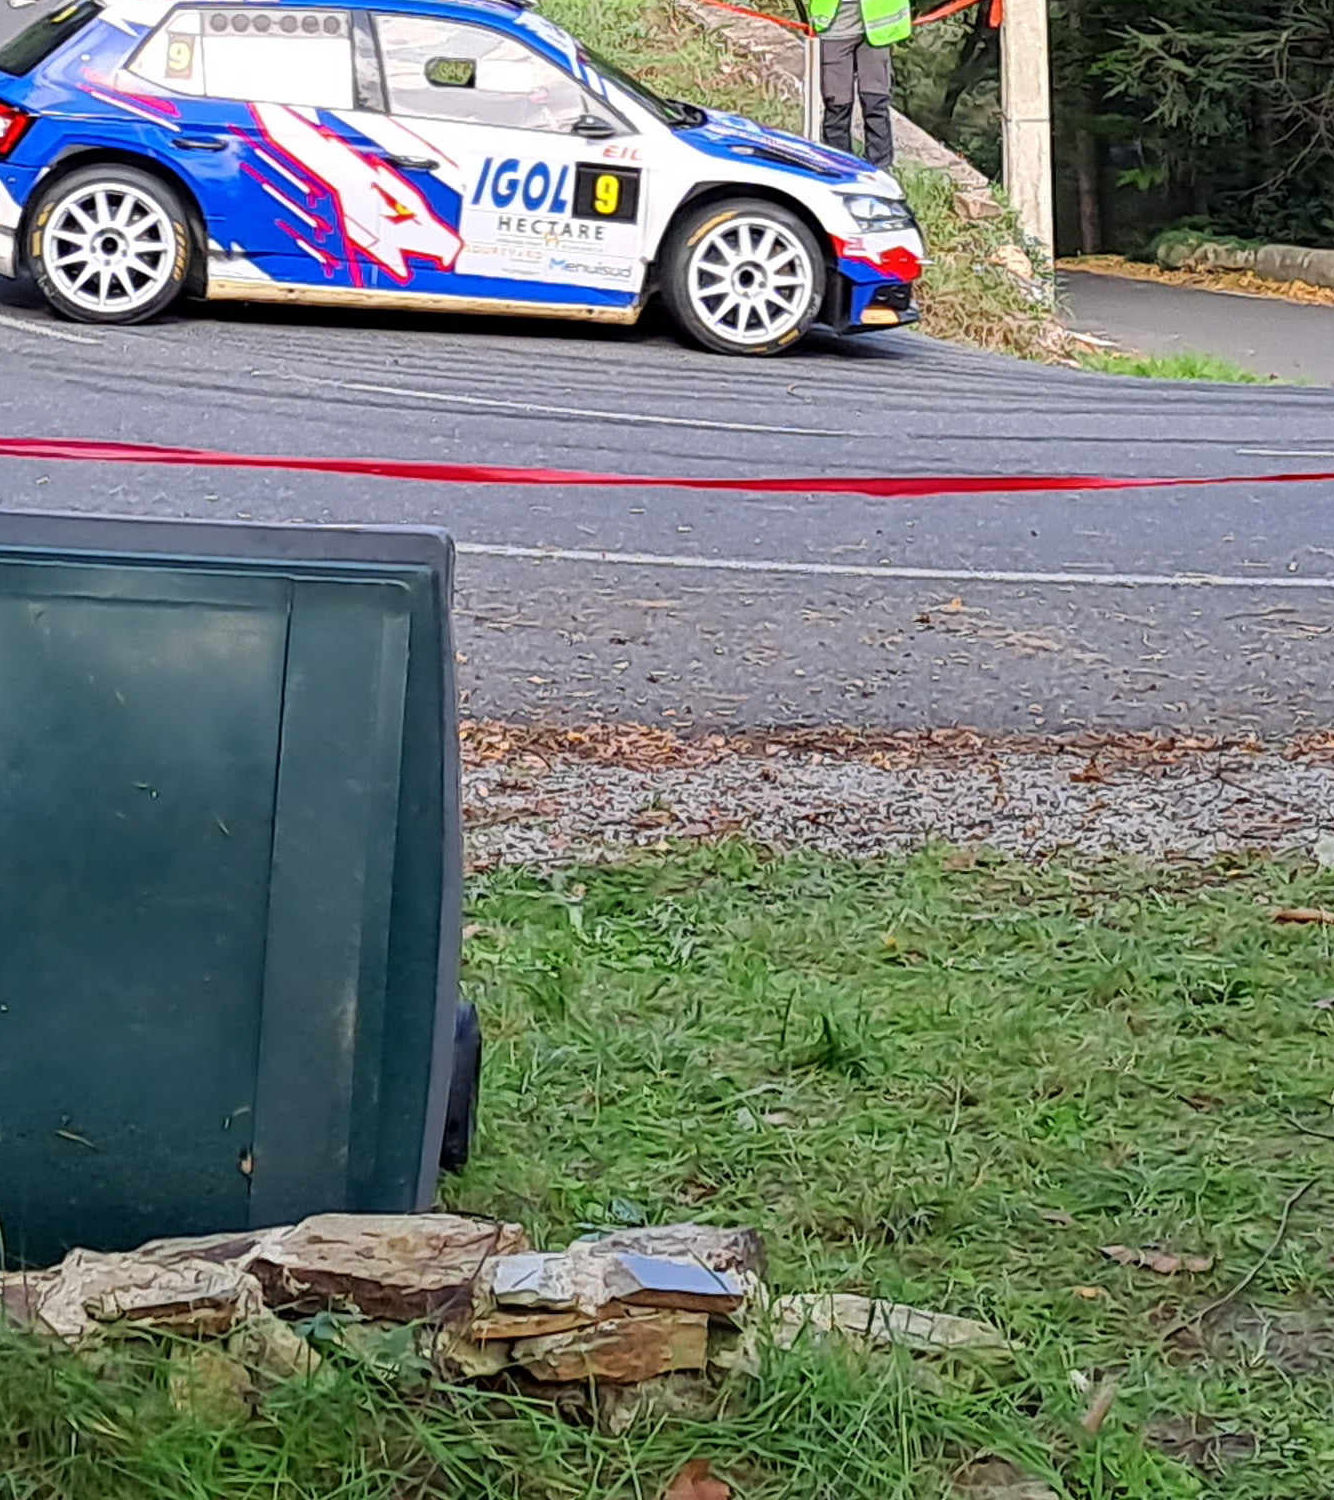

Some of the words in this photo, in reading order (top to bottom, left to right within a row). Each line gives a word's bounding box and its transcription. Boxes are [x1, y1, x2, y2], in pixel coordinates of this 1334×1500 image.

[168, 42, 191, 71] 9
[471, 157, 570, 213] IGOL
[594, 174, 620, 215] 9
[497, 216, 607, 241] HECTARE
